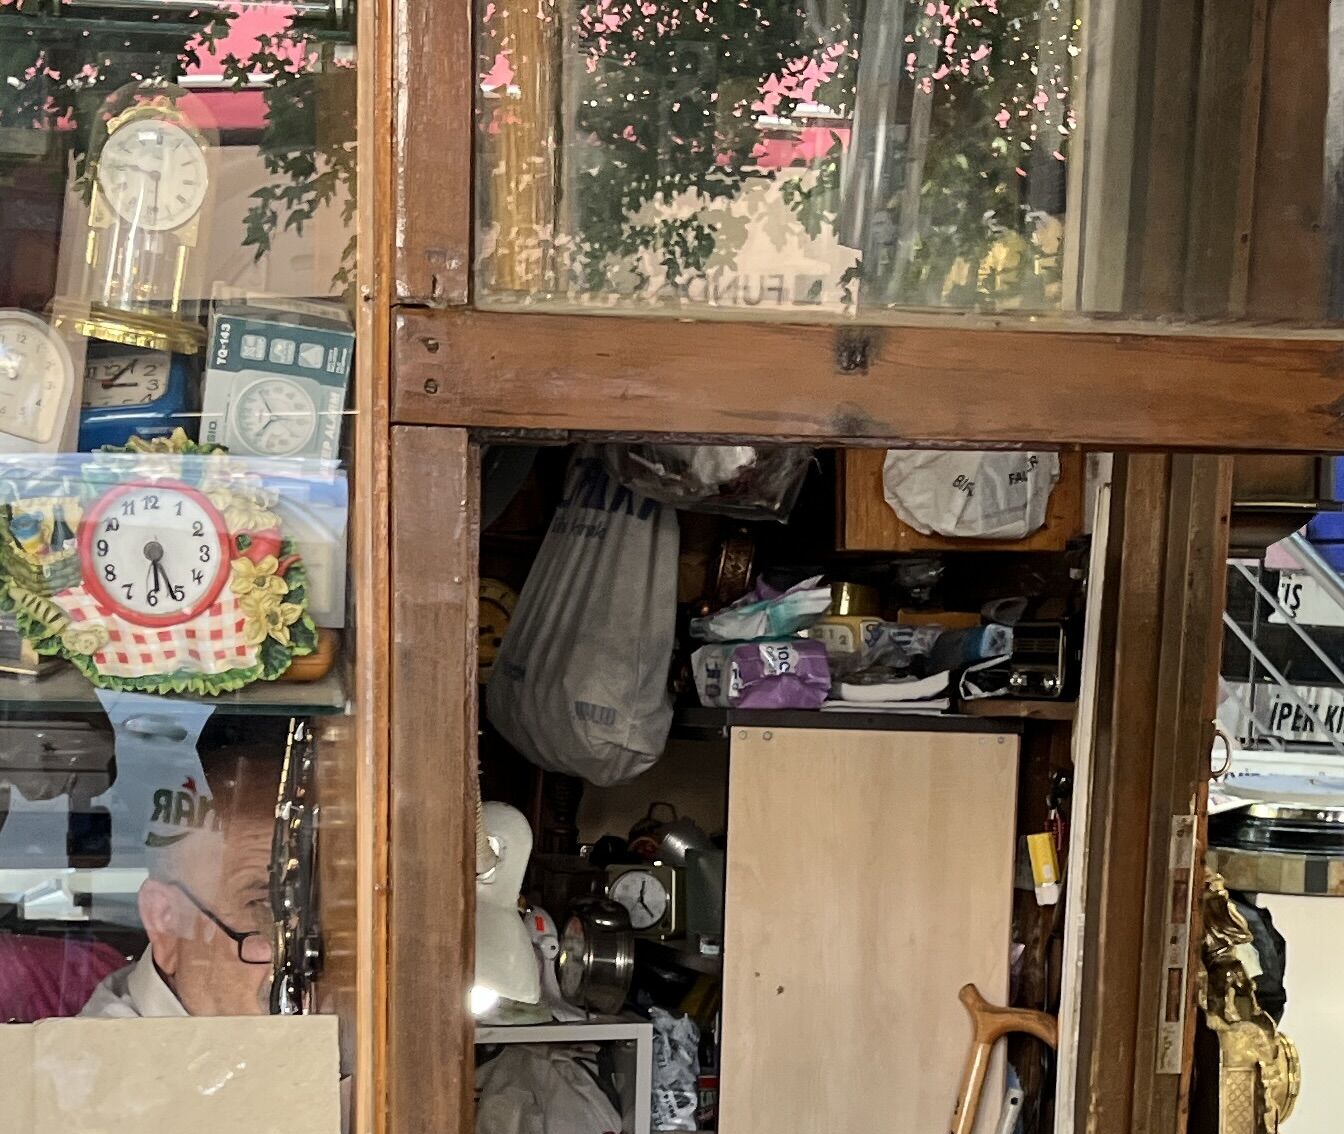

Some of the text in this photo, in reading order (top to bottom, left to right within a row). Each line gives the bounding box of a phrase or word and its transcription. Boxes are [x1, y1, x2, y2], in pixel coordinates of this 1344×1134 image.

[216, 323, 231, 365] TQ-143
[143, 365, 157, 376] 2
[146, 379, 160, 392] 3
[121, 500, 136, 516] 11
[141, 495, 160, 510] 12
[175, 501, 183, 516] 1
[104, 517, 120, 532] 10
[192, 520, 205, 537] 2
[96, 539, 109, 557] 9
[199, 544, 210, 563] 3
[104, 564, 117, 582] 8
[191, 568, 204, 585] 4
[121, 582, 134, 600] 7
[147, 589, 158, 607] 6
[173, 585, 185, 602] 5
[839, 634, 848, 645] 2
[1269, 694, 1320, 733] İPEK
